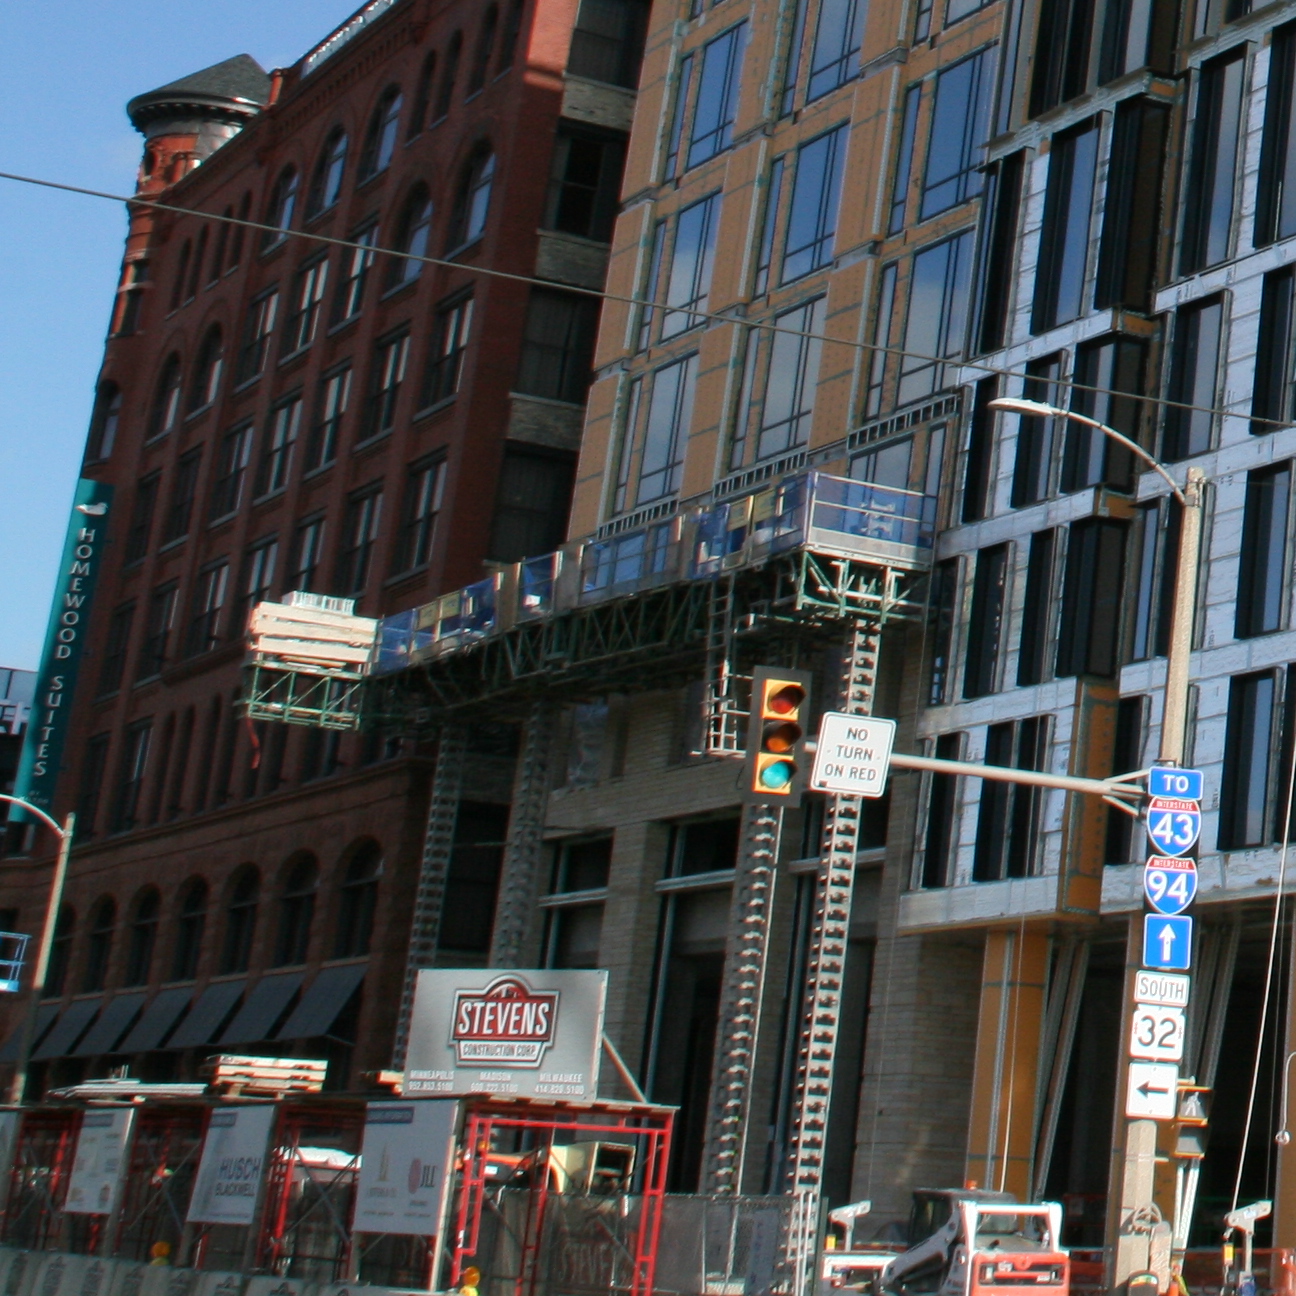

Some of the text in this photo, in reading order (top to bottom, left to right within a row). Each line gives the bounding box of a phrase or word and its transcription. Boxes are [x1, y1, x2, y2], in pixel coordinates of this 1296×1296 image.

[57, 527, 95, 660] HOMEWOOD
[33, 675, 65, 776] SUITES
[846, 727, 868, 741] NO
[836, 745, 874, 761] TURN
[825, 764, 877, 781] ON RED
[1163, 774, 1190, 793] TO
[1156, 800, 1193, 811] INTERSTATE
[1152, 813, 1194, 846] 43
[1153, 859, 1190, 869] INTERSTATE
[1148, 870, 1188, 905] 94
[1140, 976, 1184, 1000] SOUTH
[459, 1001, 549, 1035] STEVENS
[1138, 1015, 1176, 1049] 32
[539, 1073, 583, 1083] MILWAUKEE
[219, 1157, 262, 1180] HUSCH
[215, 1182, 256, 1197] BLACKWELL
